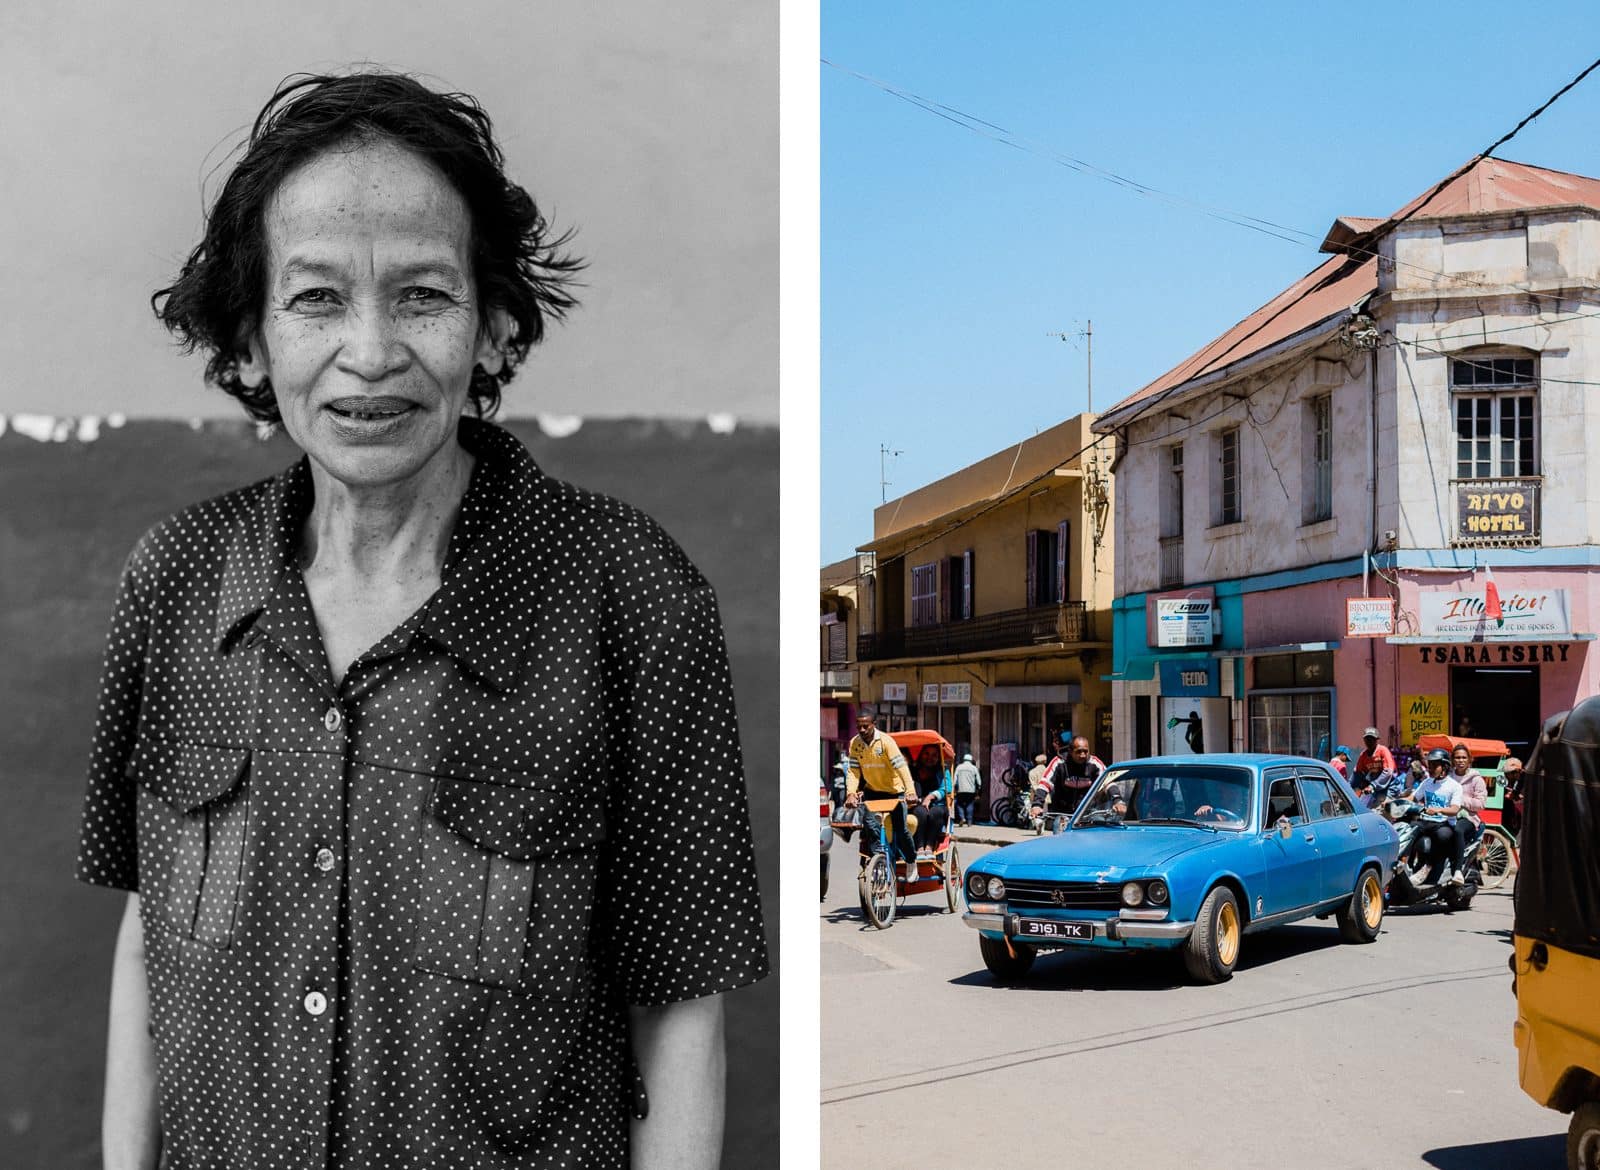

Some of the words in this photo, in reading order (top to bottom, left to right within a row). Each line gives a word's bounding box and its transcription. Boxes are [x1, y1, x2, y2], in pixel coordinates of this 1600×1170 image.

[1467, 492, 1524, 511] RIVO
[1467, 514, 1526, 532] HOTEL
[1420, 645, 1491, 664] TSARA
[1498, 643, 1570, 663] TSIRY
[1410, 719, 1442, 732] DEPOT
[1029, 922, 1058, 934] 3161
[1064, 925, 1082, 937] TK
